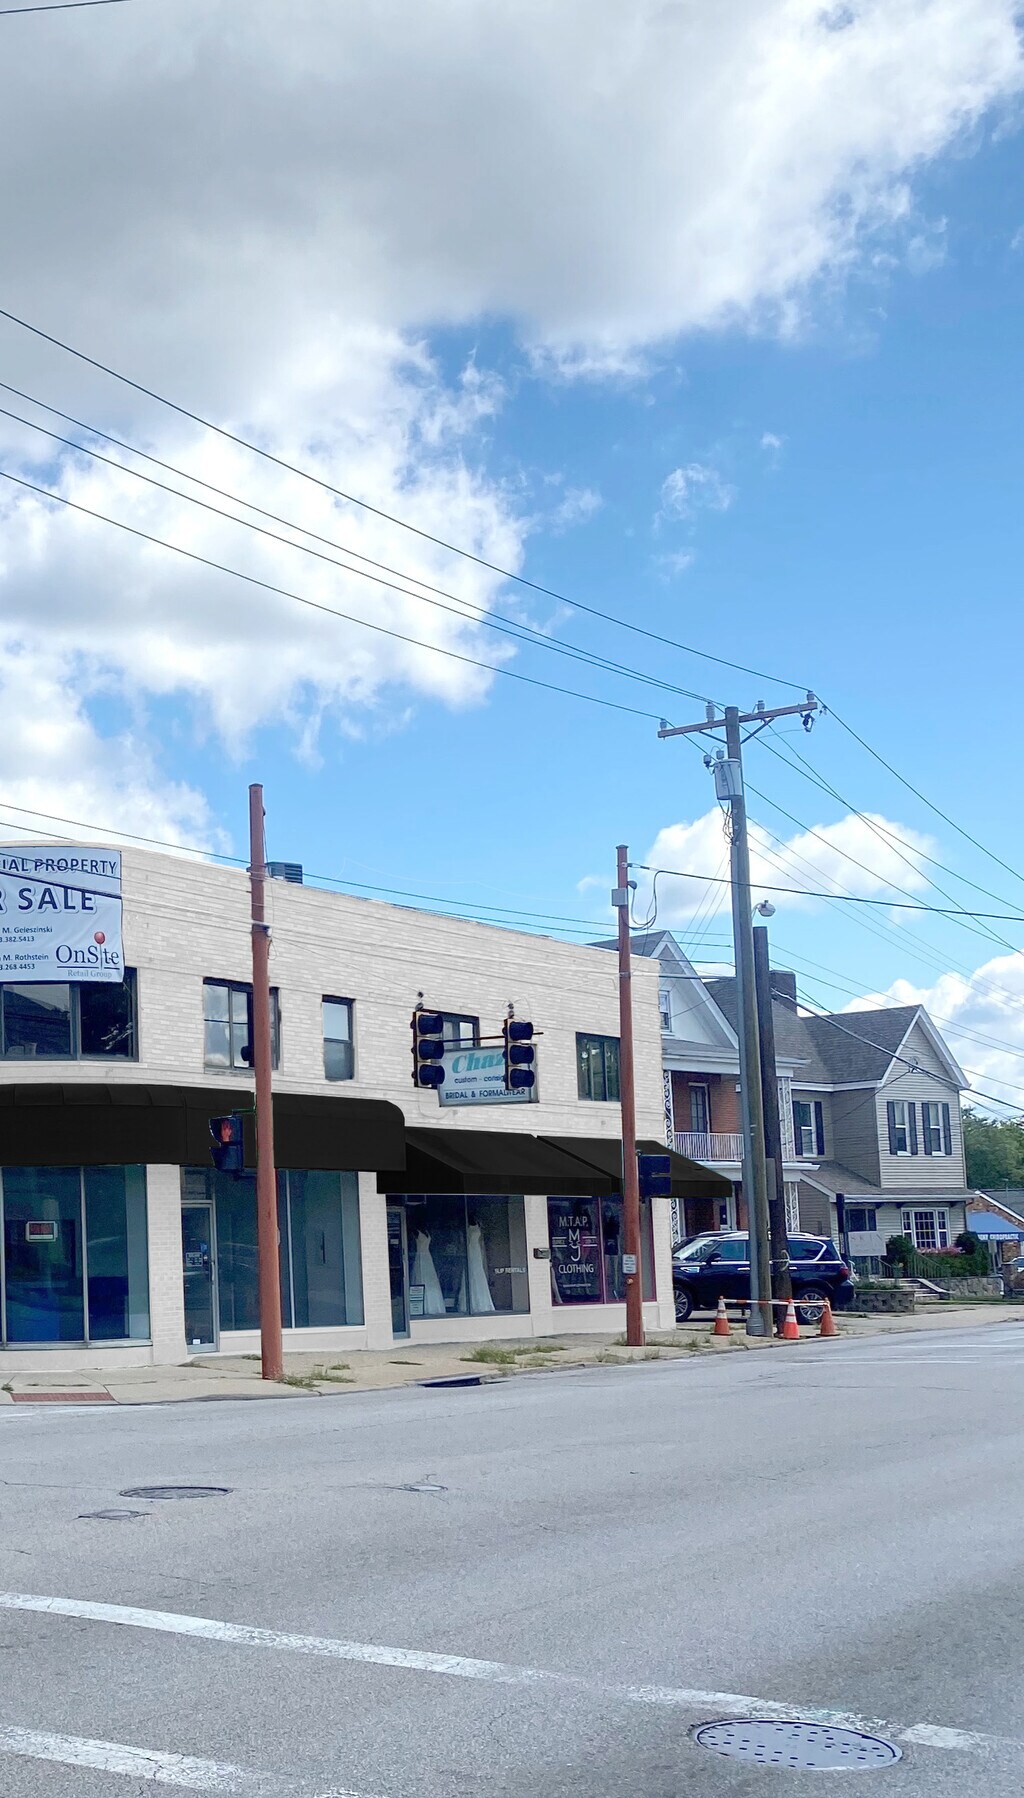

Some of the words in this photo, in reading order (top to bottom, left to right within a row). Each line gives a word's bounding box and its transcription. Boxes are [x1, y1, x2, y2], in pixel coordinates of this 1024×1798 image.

[34, 858, 117, 874] PROPERTY
[18, 887, 94, 911] SALE
[14, 953, 49, 961] Rothstein
[56, 943, 120, 970] OnSite
[67, 969, 89, 977] Retail
[90, 969, 113, 979] Group
[454, 1076, 478, 1084] custom
[445, 1091, 468, 1100] BRIDAL
[558, 1263, 595, 1274] CLOTHING
